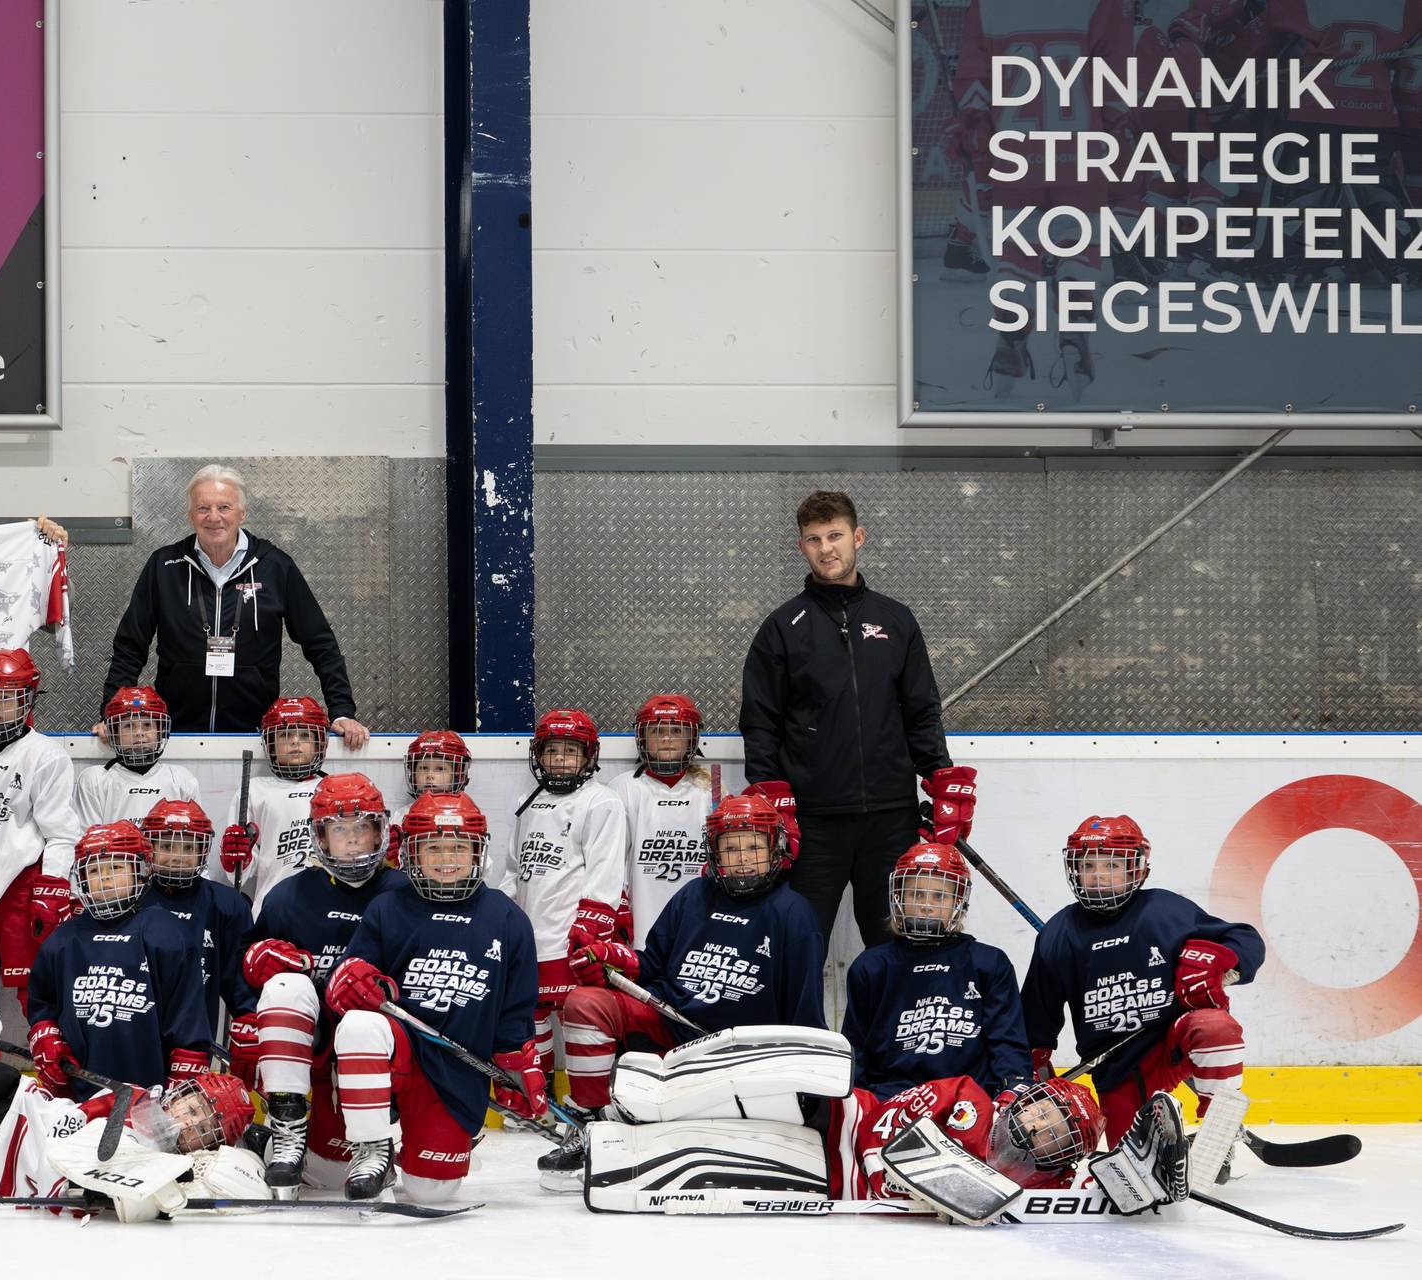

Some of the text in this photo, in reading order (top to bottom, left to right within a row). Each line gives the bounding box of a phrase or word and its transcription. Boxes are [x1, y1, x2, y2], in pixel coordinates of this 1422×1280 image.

[992, 56, 1335, 109] DYNAMIK
[988, 131, 1380, 184] STRATEGIE
[549, 722, 575, 731] CCM
[531, 803, 556, 811] CCM
[641, 839, 698, 851] GOALS
[638, 850, 708, 863] DREAMS
[655, 863, 682, 882] 25
[32, 886, 72, 898] AUER
[431, 912, 473, 924] CCM
[711, 912, 750, 926] CCM
[93, 934, 132, 943] CCM
[1091, 935, 1131, 951] CCM
[408, 957, 478, 979] GOALS
[477, 969, 491, 981] &
[686, 949, 761, 975] GOALS &
[913, 963, 952, 973] CCM
[74, 976, 148, 992] GOALS &
[403, 971, 487, 997] DREAMS
[679, 963, 757, 992] DREAMS
[72, 988, 148, 1010] DREAMS
[419, 987, 457, 1013] 25
[692, 980, 724, 1004] 25
[1084, 976, 1163, 1006] GOALS &
[900, 1004, 975, 1024] GOALS &
[1084, 990, 1169, 1019] DREAMS
[88, 1003, 115, 1028] 25
[1111, 1009, 1143, 1034] 25
[896, 1018, 975, 1040] DREAMS
[914, 1031, 946, 1056] 25
[418, 1149, 471, 1164] BAUER
[83, 1167, 144, 1188] CCM
[755, 1200, 834, 1214] BAUER
